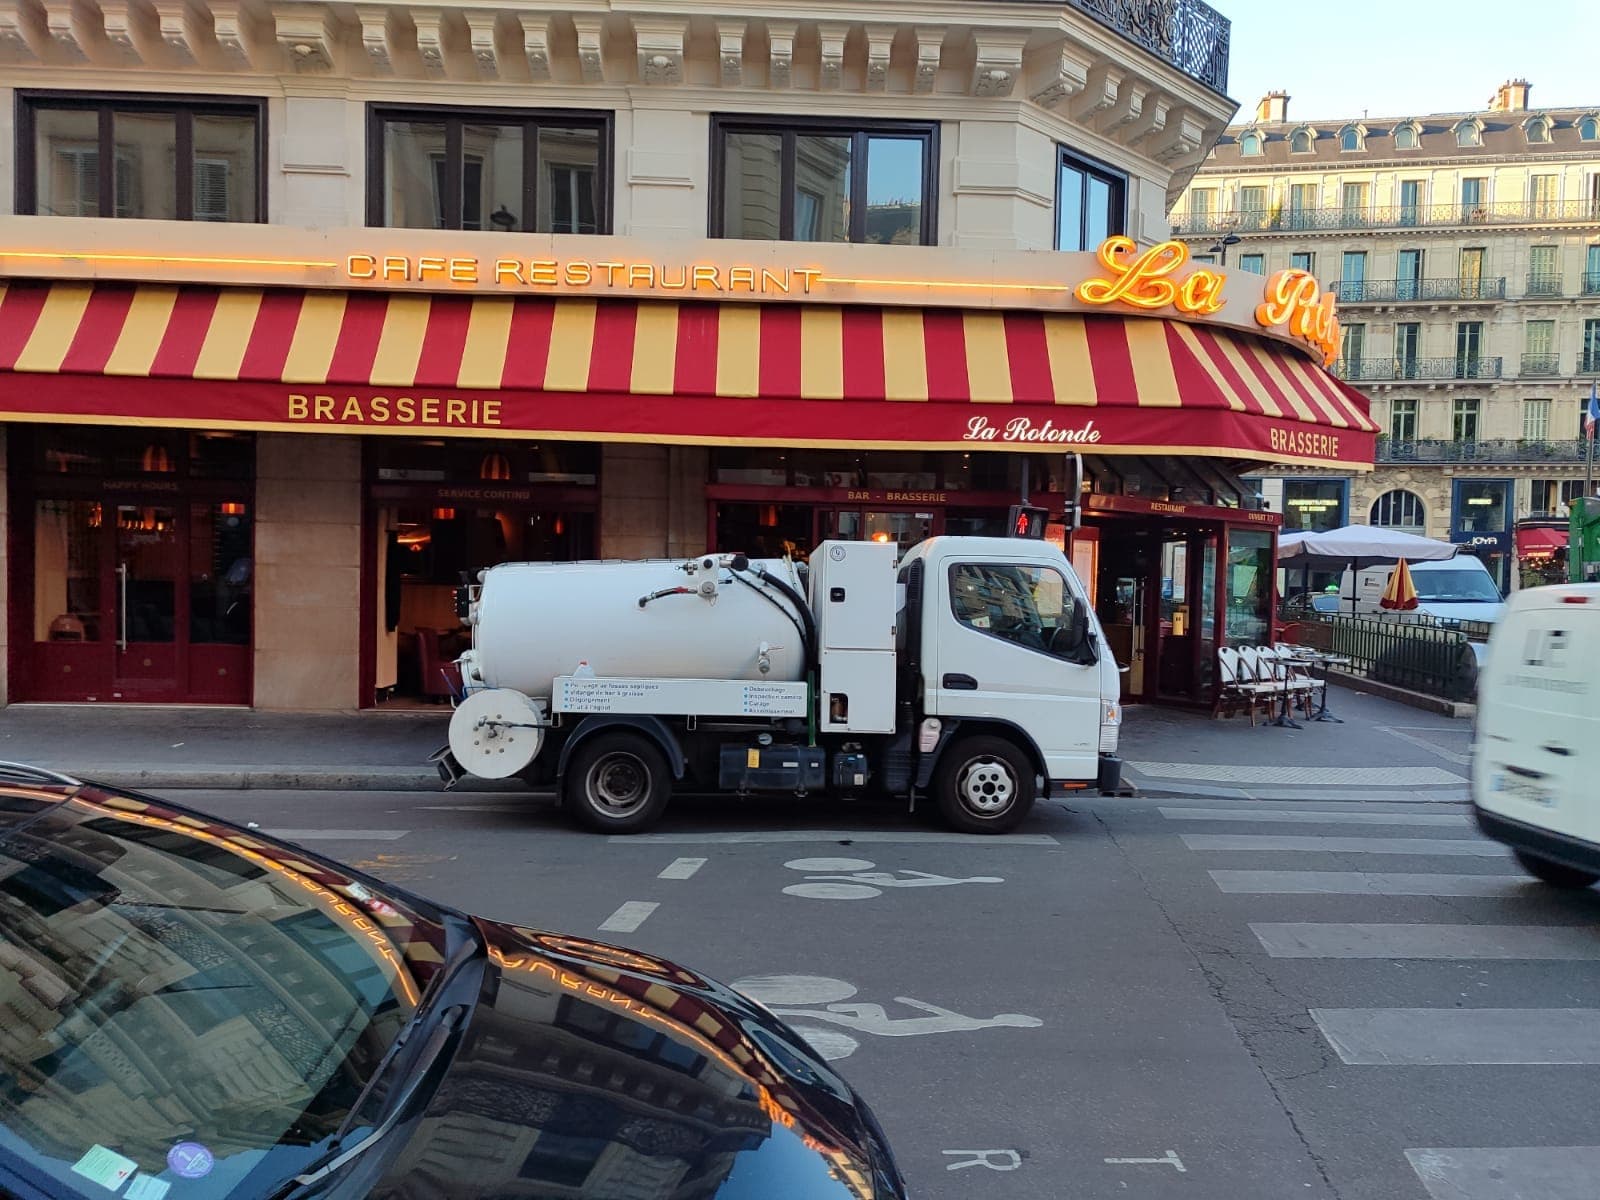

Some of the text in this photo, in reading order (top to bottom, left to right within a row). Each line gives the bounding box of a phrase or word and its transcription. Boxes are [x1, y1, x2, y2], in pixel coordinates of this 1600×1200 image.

[346, 254, 823, 293] CAFE RESTAURANT
[1076, 235, 1228, 313] La
[288, 394, 502, 425] BRASSERIE
[963, 416, 1101, 442] La Rotonde
[1270, 427, 1340, 457] BRASSERIE
[848, 491, 870, 500] BAR
[886, 492, 946, 502] BRASSERIE
[1150, 502, 1186, 513] RESTAURANT
